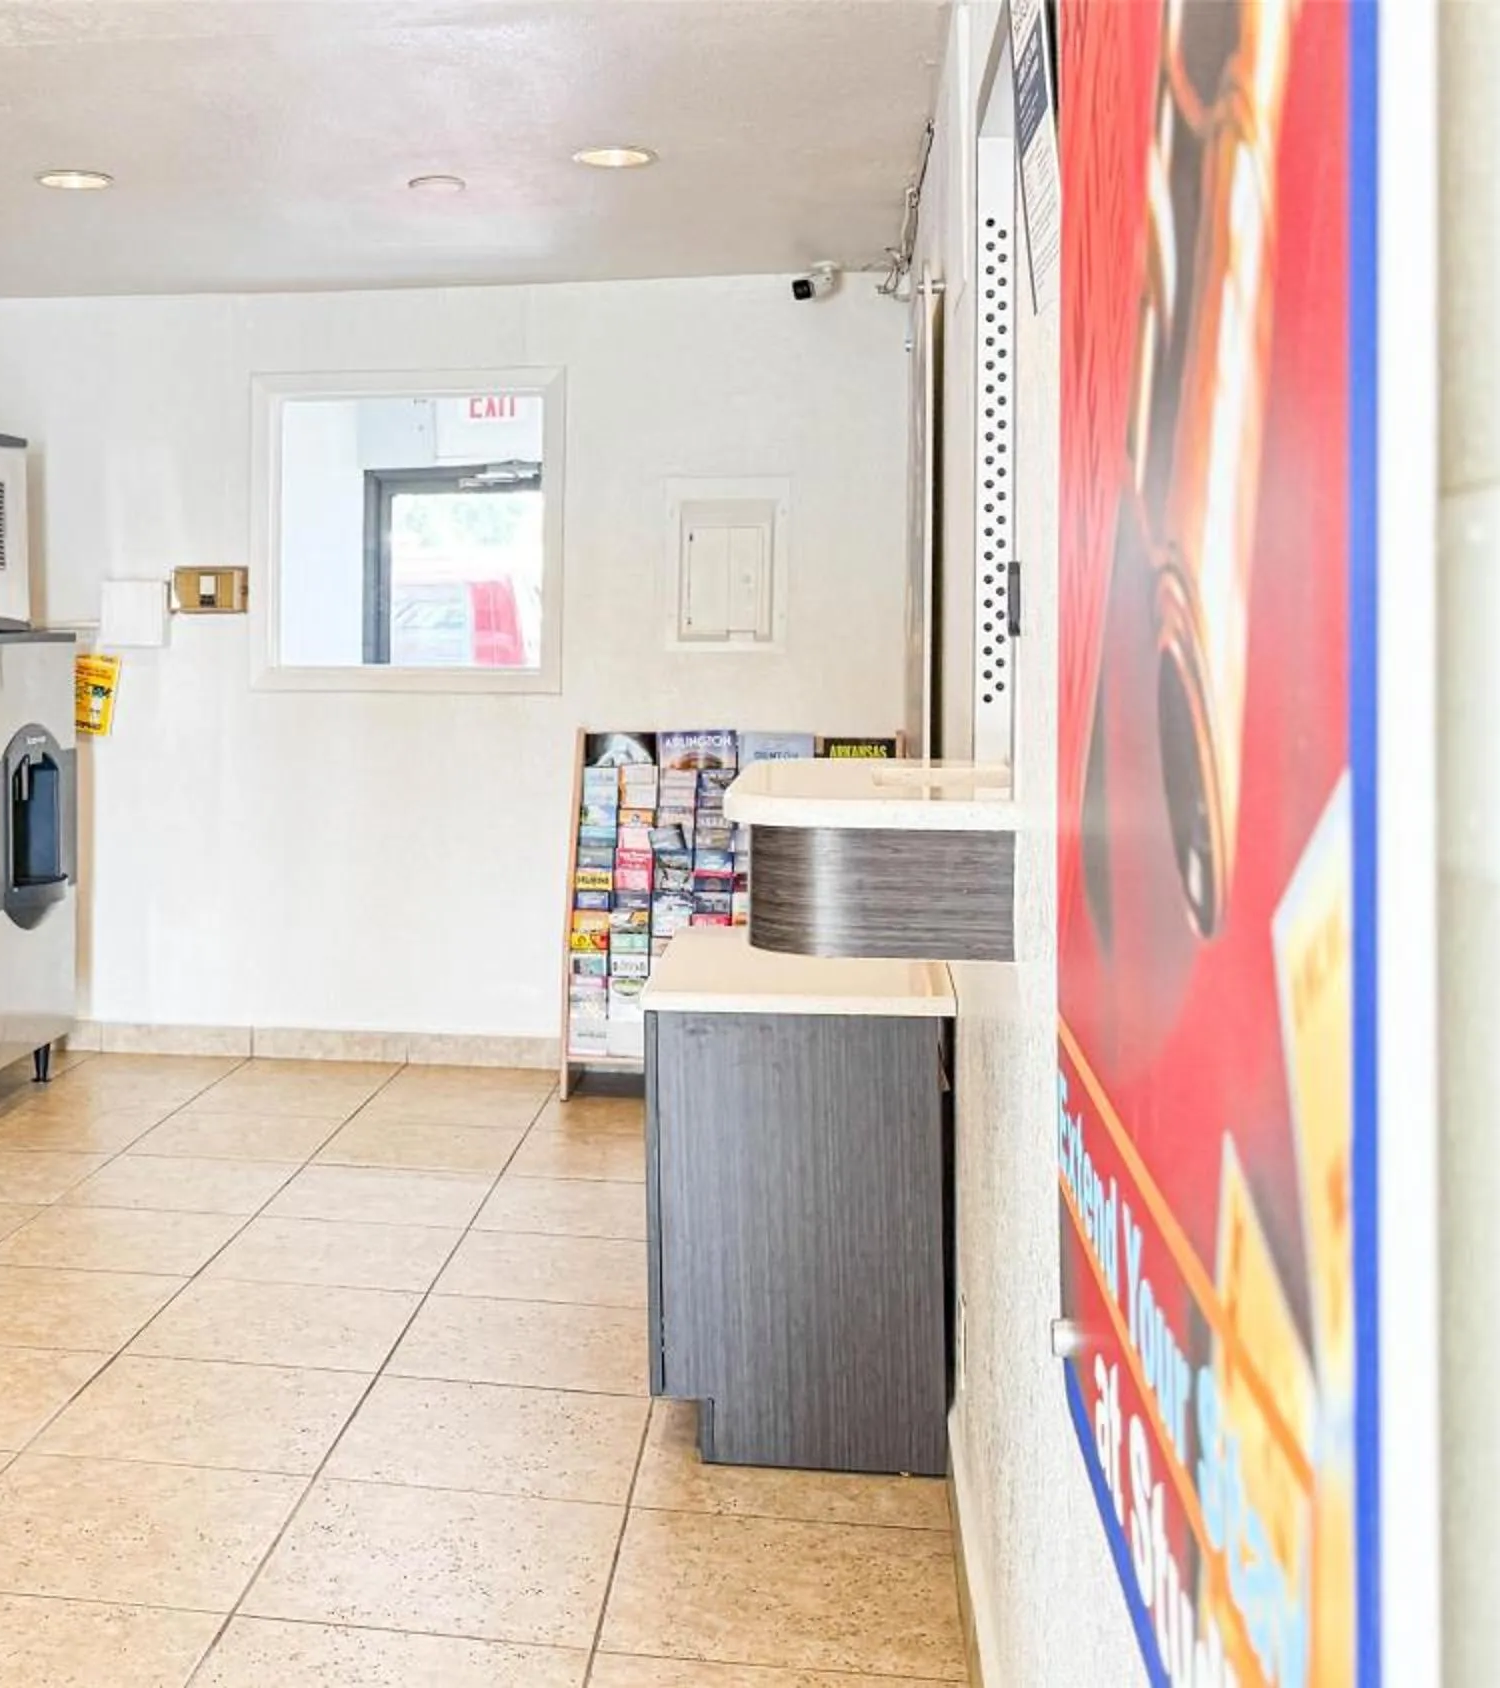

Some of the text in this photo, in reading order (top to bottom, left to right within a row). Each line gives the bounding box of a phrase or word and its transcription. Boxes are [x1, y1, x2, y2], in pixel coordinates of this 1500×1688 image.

[829, 744, 888, 758] ARKANSAS
[1058, 1072, 1118, 1302] Extend
[1122, 1199, 1191, 1467] Your
[1094, 1353, 1124, 1527] at
